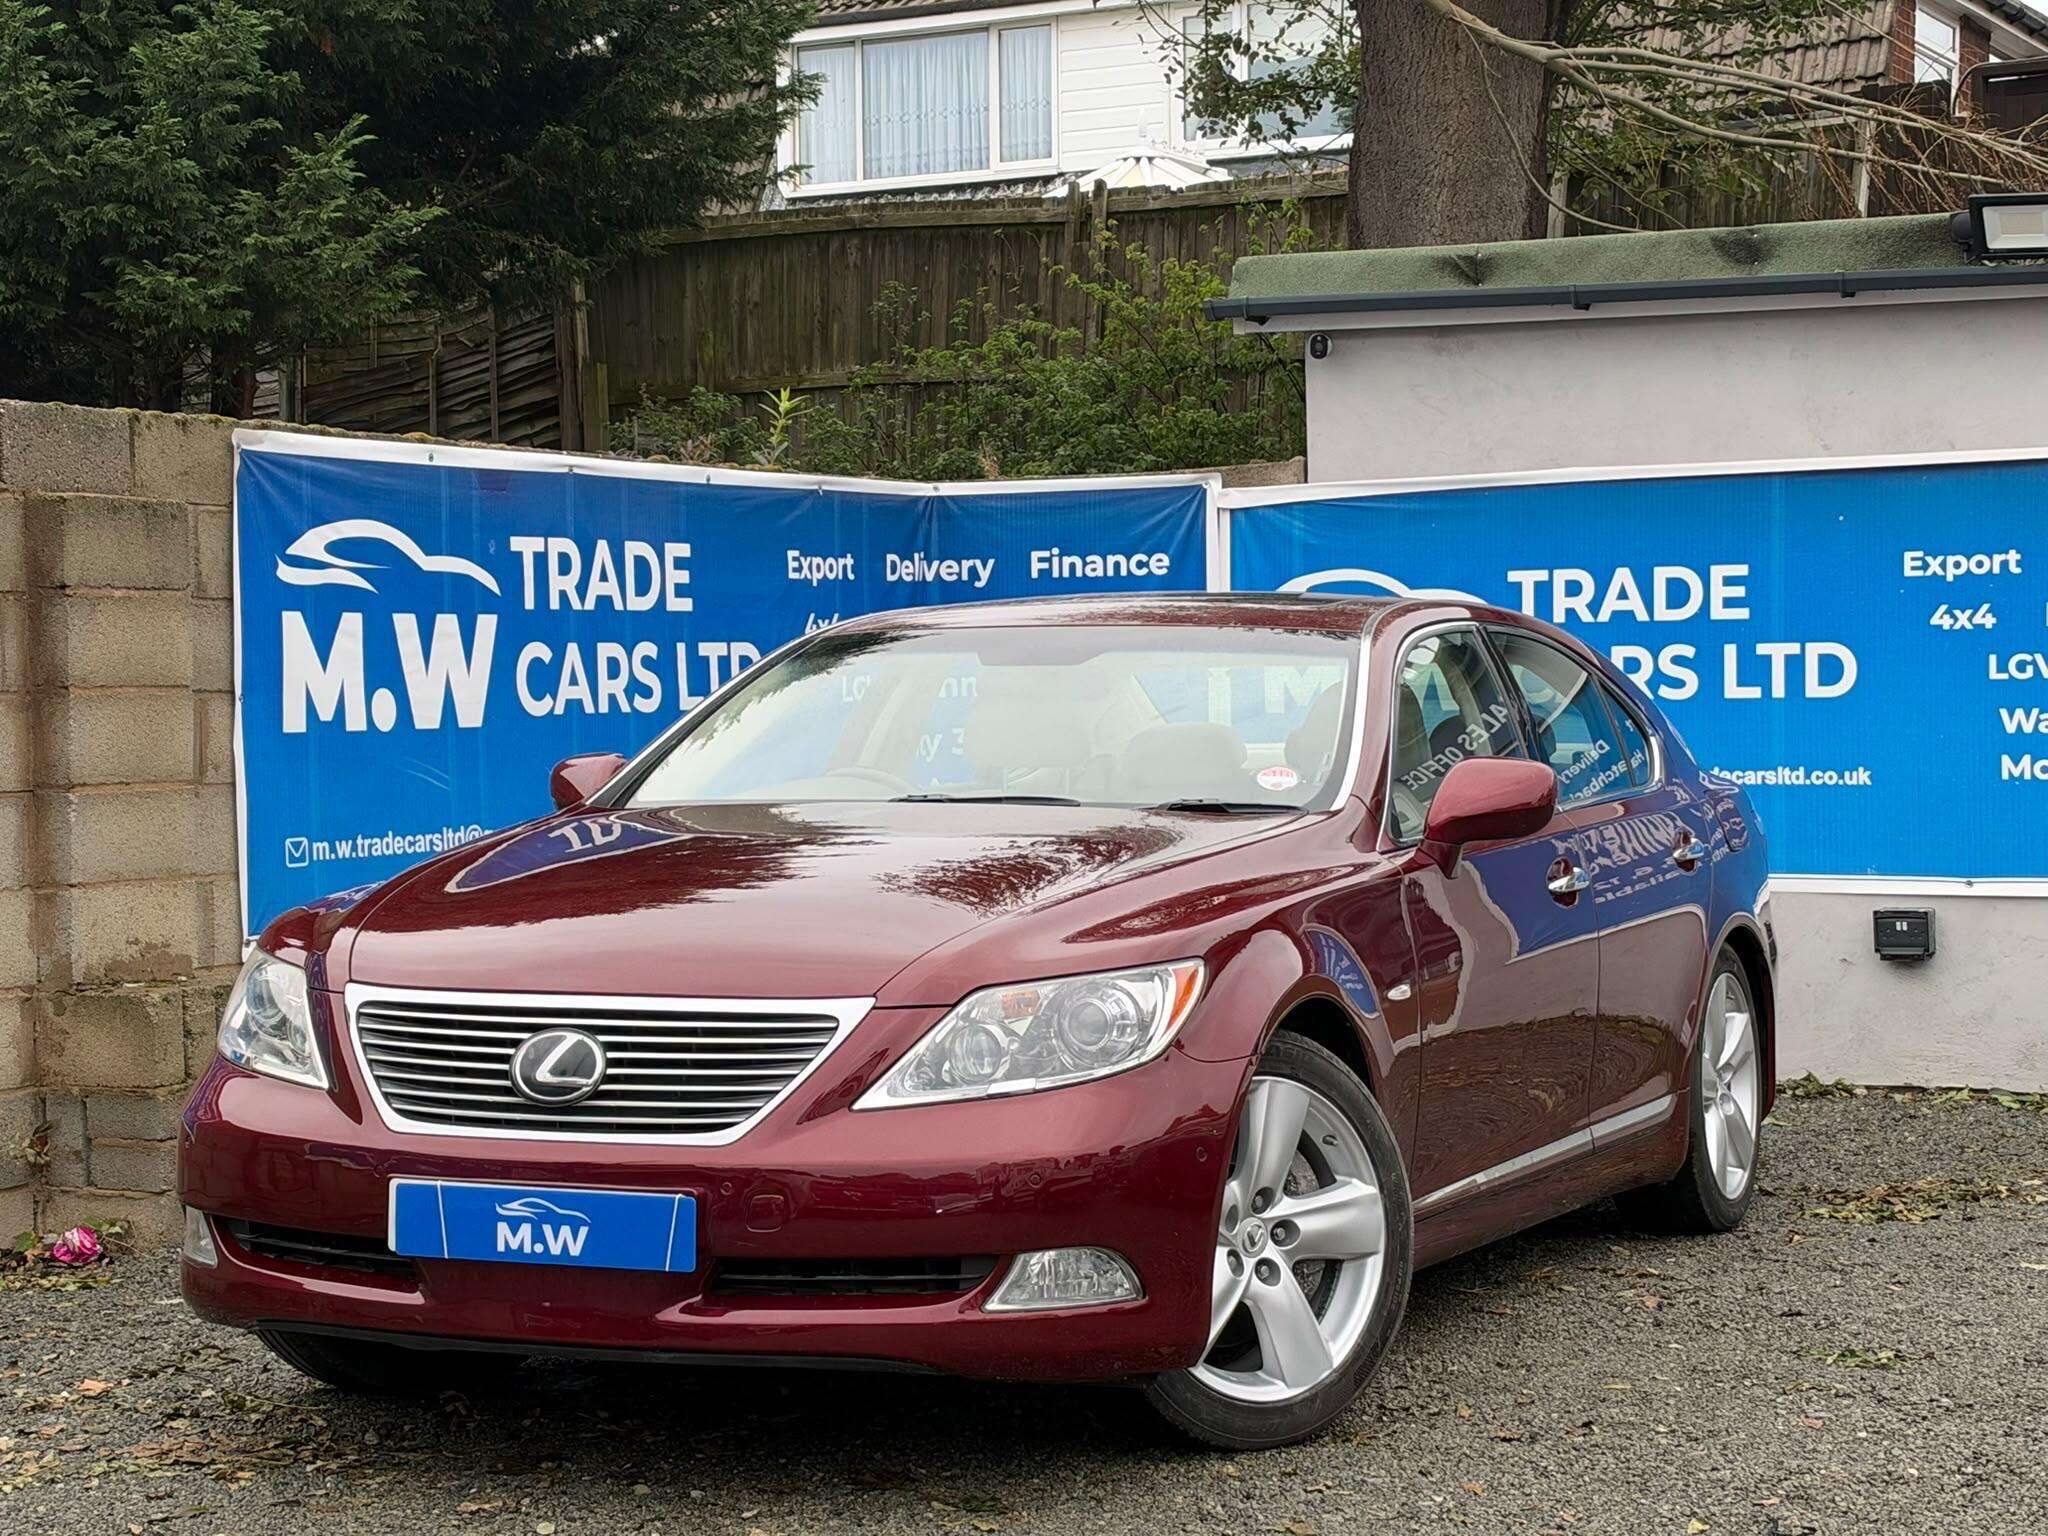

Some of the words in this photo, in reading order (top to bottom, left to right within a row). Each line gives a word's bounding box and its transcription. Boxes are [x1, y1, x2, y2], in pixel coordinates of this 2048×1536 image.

[510, 536, 693, 612] TRADE
[786, 550, 855, 587] Export
[886, 552, 995, 588] Delivery
[1030, 547, 1170, 579] Finance
[1903, 549, 2022, 582] Export
[1507, 564, 1750, 623] TRADE
[1929, 603, 1997, 630] 4x4
[281, 610, 498, 733] M.W
[516, 641, 662, 717] CARS
[1610, 643, 1699, 702] RS
[1723, 642, 1858, 699] LTD
[312, 824, 493, 862] m.w.tradecarsltd@
[497, 1221, 589, 1256] M.W
